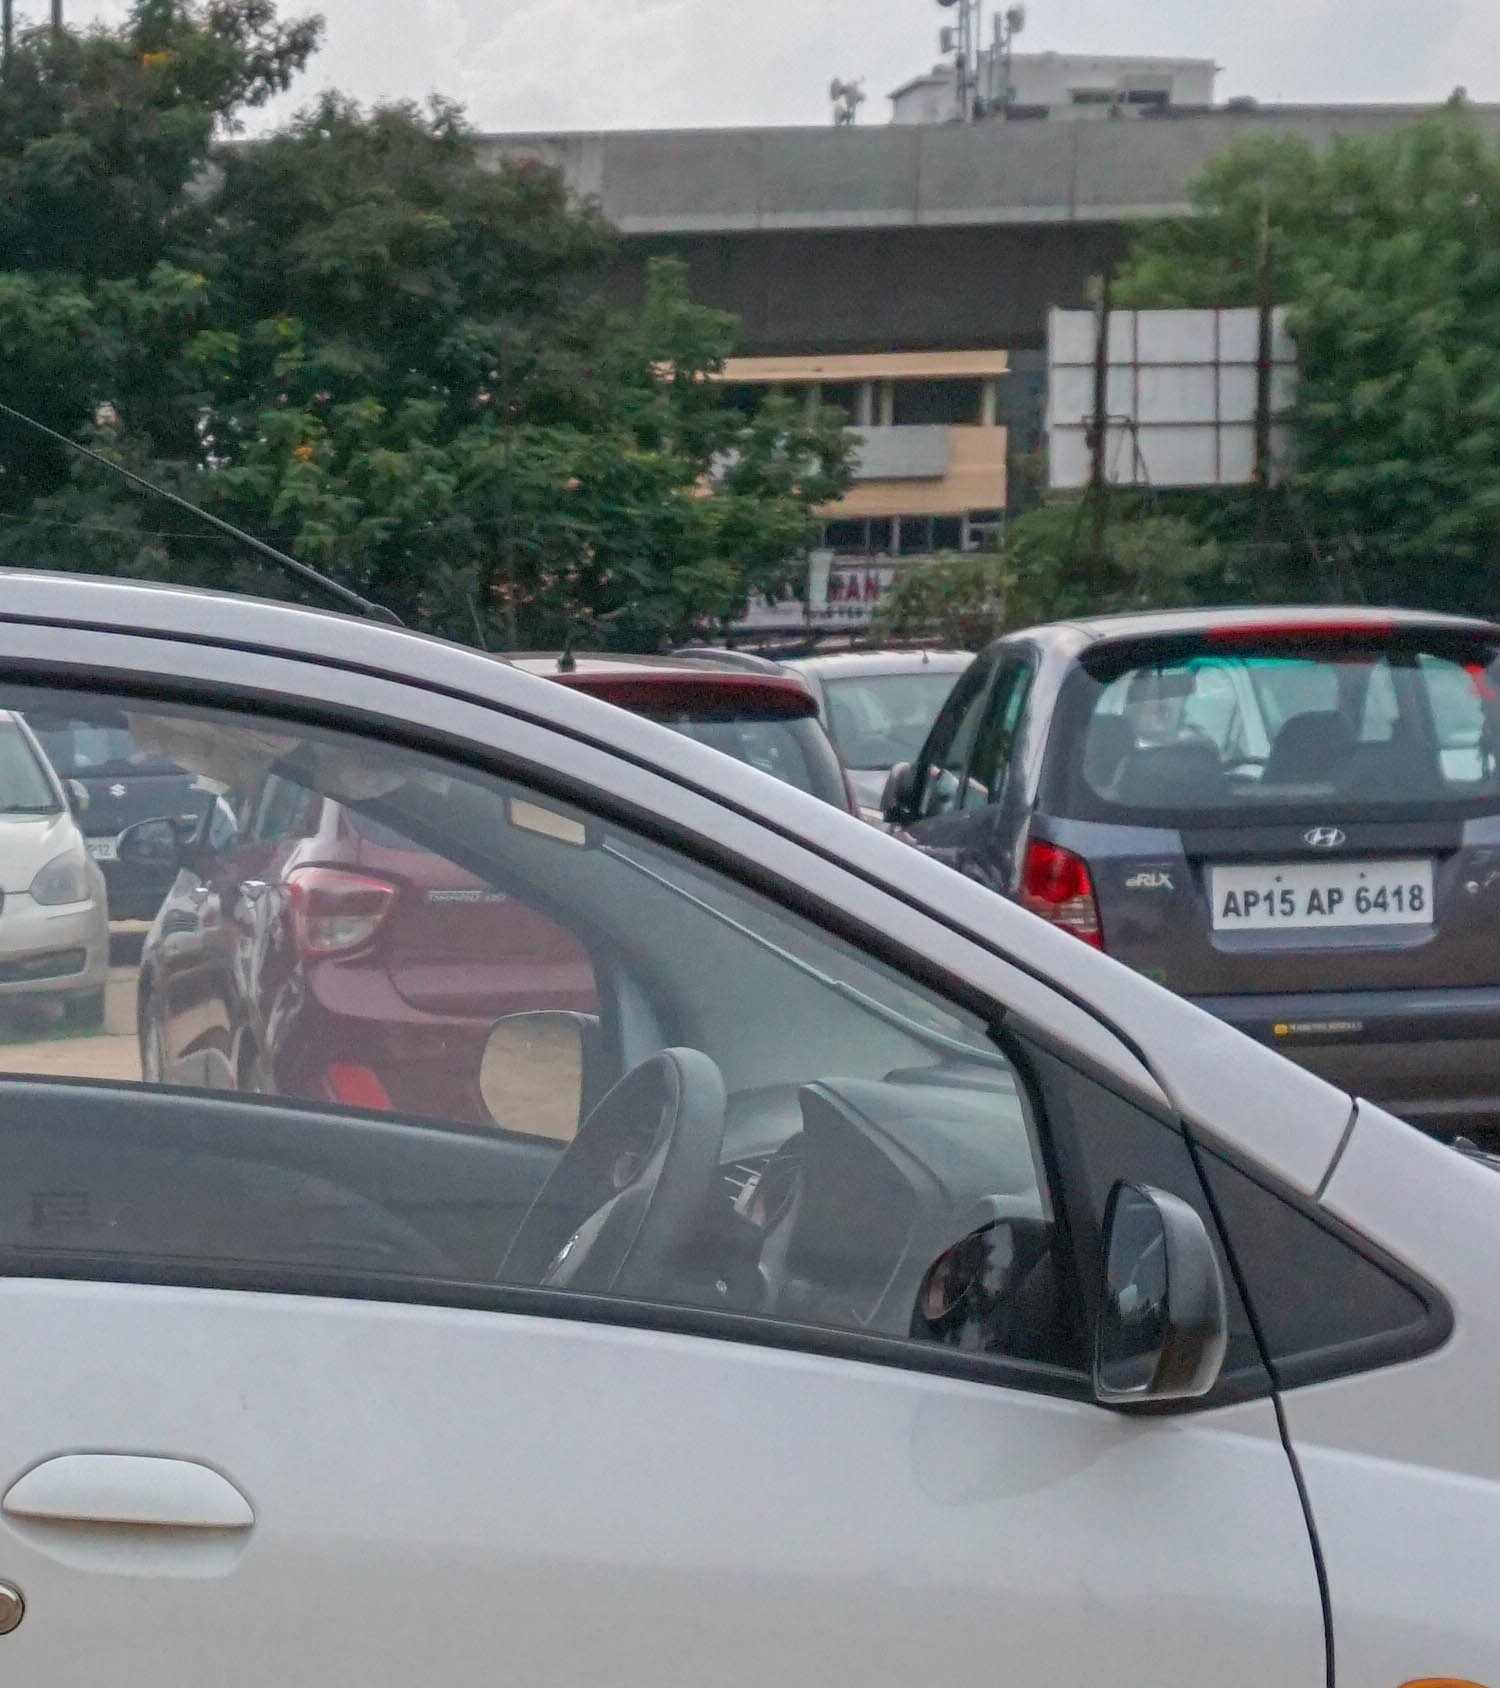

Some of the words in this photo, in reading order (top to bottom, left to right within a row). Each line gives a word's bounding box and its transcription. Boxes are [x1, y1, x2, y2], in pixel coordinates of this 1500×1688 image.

[1222, 889, 1295, 918] AP15
[1306, 887, 1344, 916] AP
[1355, 884, 1424, 914] 6418
